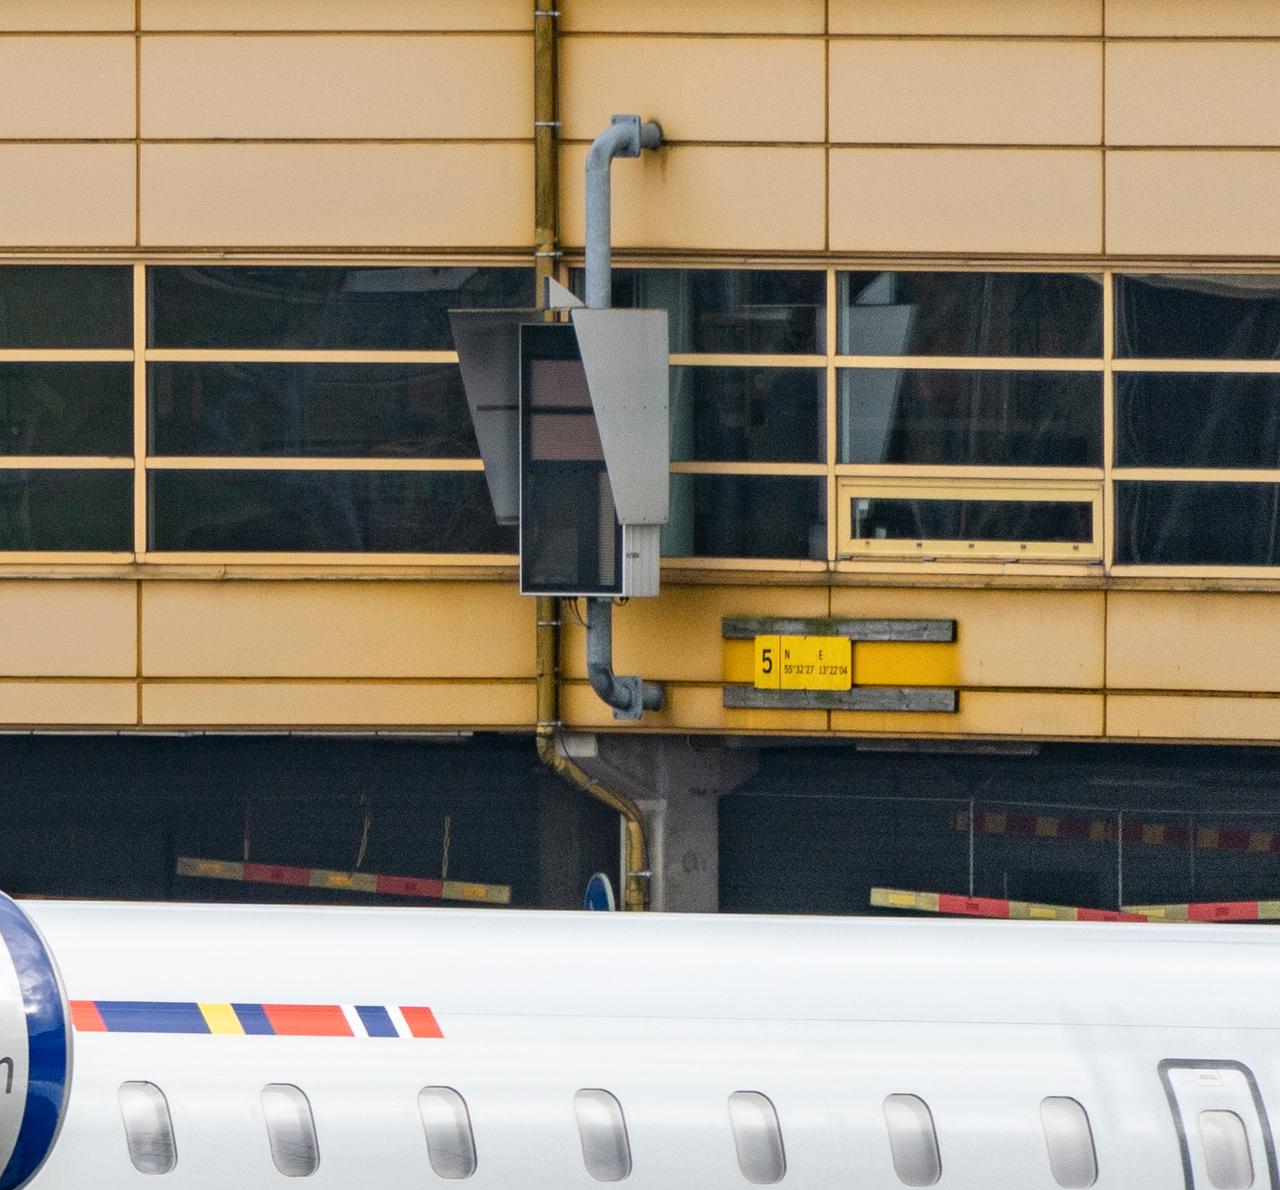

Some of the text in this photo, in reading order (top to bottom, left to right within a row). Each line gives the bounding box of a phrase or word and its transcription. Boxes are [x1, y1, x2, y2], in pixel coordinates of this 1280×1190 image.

[762, 649, 773, 674] 5
[784, 649, 823, 660] N E
